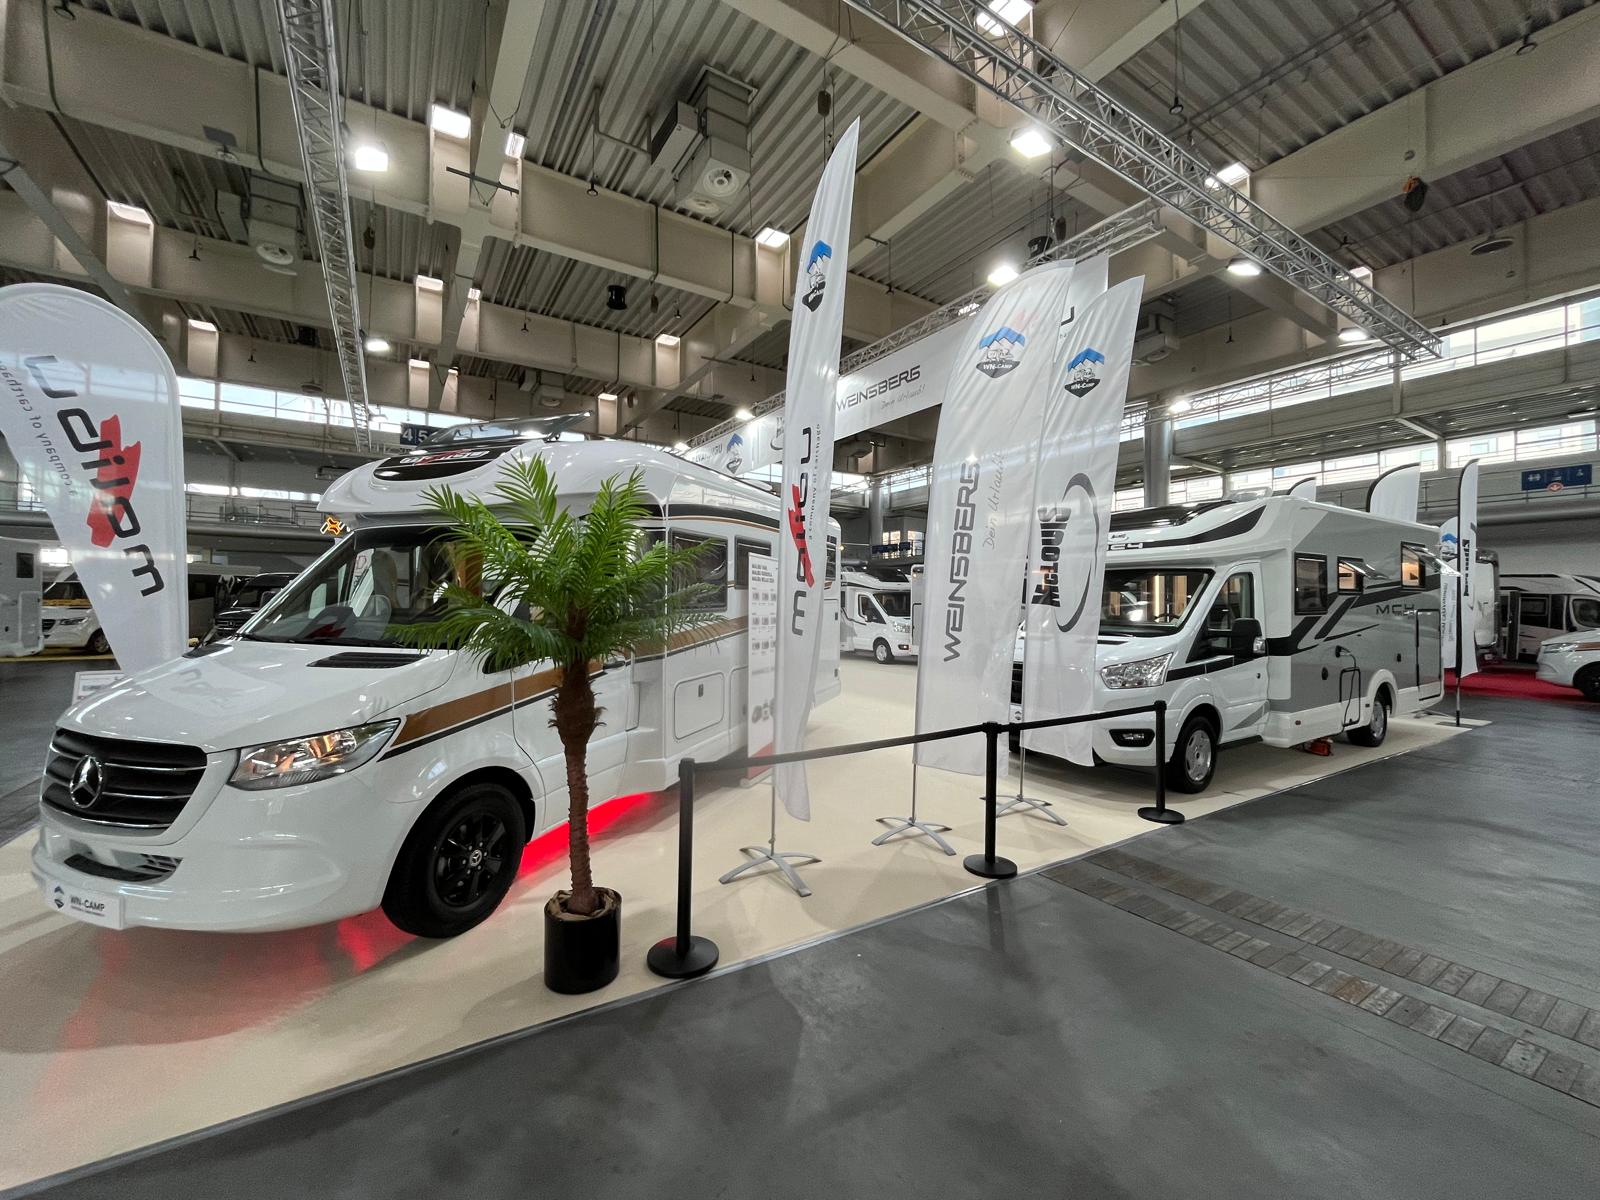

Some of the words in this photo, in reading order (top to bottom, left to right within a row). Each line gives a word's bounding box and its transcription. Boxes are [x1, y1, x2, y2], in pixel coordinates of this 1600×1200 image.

[836, 364, 922, 412] WEINSBERG
[791, 426, 812, 636] malibu
[943, 462, 981, 662] WEINSBERG
